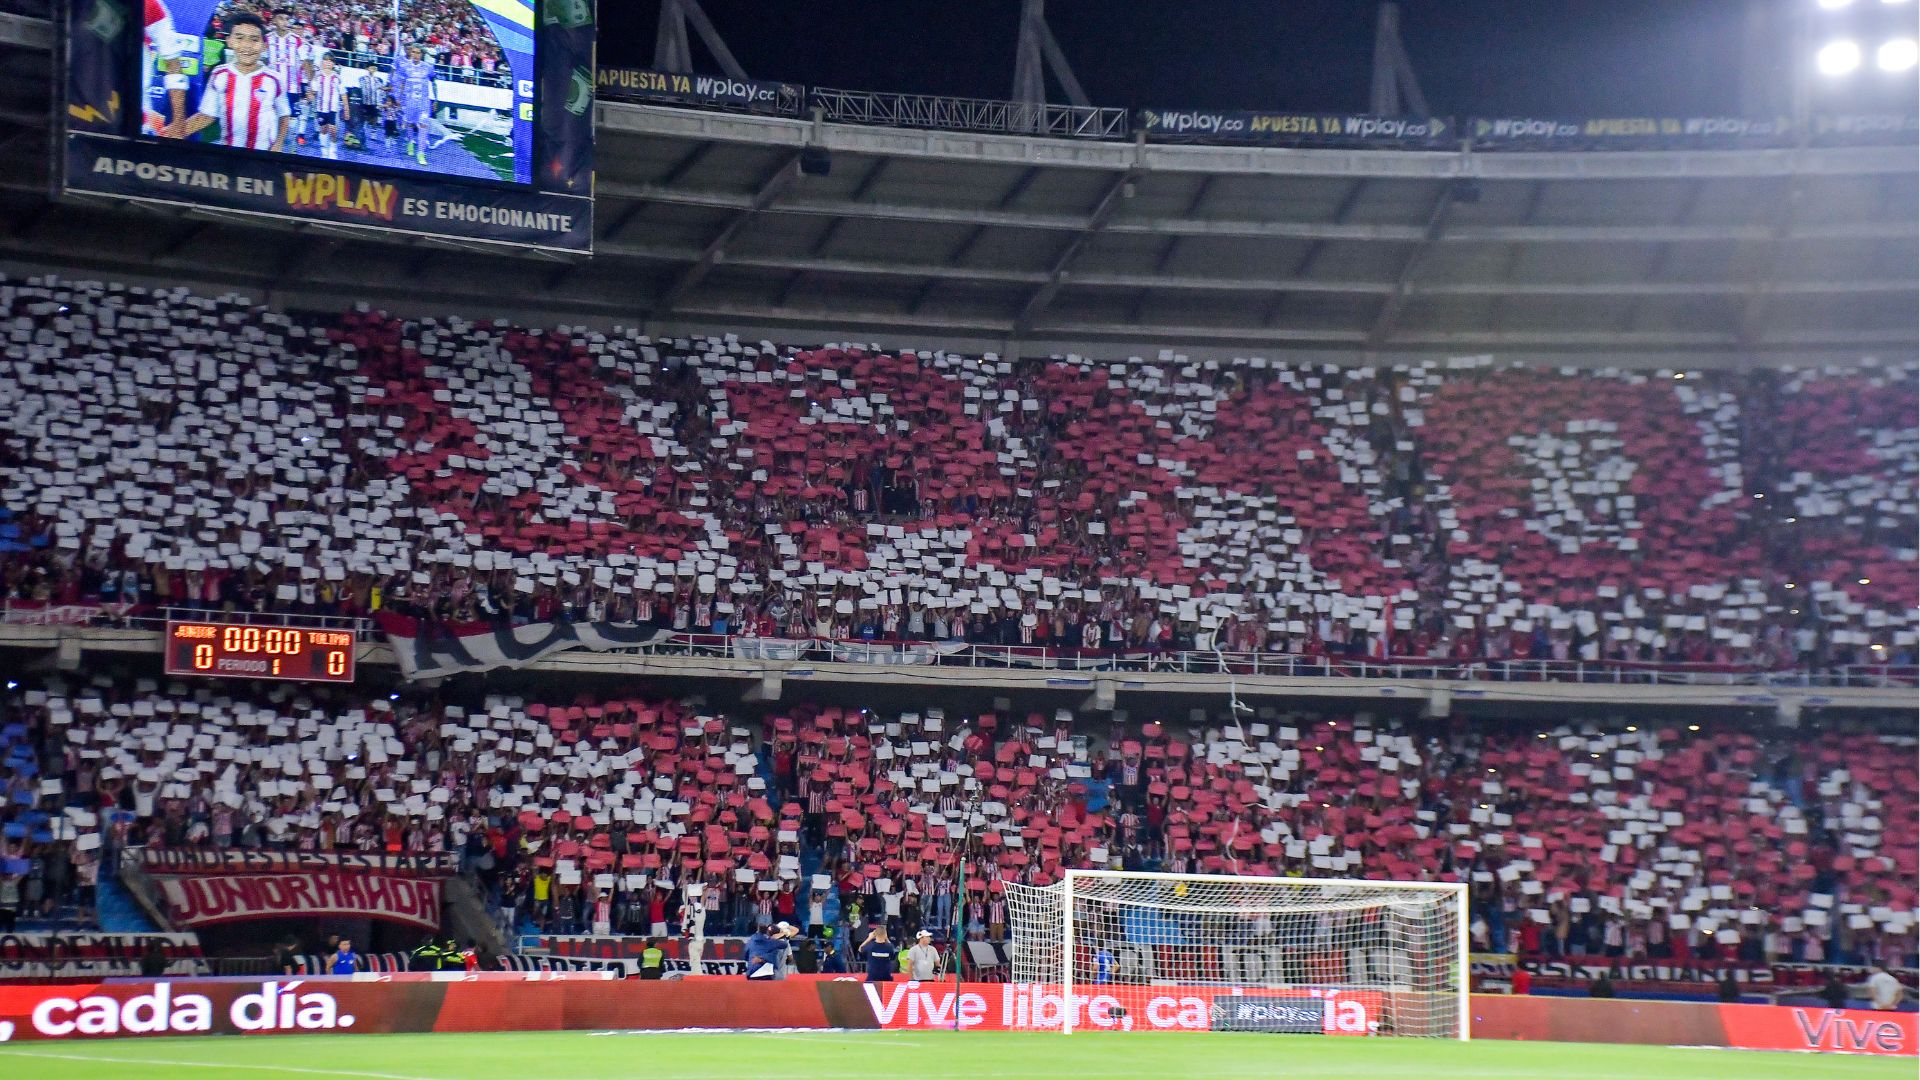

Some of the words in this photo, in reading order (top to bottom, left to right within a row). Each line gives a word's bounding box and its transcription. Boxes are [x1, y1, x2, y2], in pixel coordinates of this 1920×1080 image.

[598, 69, 667, 91] APUESTA
[671, 75, 691, 94] YA
[1162, 111, 1243, 133] Wplay.co
[1250, 116, 1318, 133] APUESTA
[1323, 116, 1341, 133] YA
[93, 156, 229, 191] APOSTAR
[236, 176, 274, 197] EN
[284, 171, 396, 219] WPLAY
[403, 198, 429, 217] ES
[435, 201, 572, 233] EMOCIONANTE
[195, 644, 214, 670] 0
[217, 658, 268, 673] PERIODO
[272, 658, 281, 675] 1
[328, 651, 345, 676] 0
[224, 627, 301, 655] 00:00
[307, 632, 351, 646] TOLIMA
[32, 982, 212, 1036] cada
[230, 980, 355, 1031] día.
[864, 981, 987, 1026] Vive
[1792, 1007, 1905, 1051] Vive
